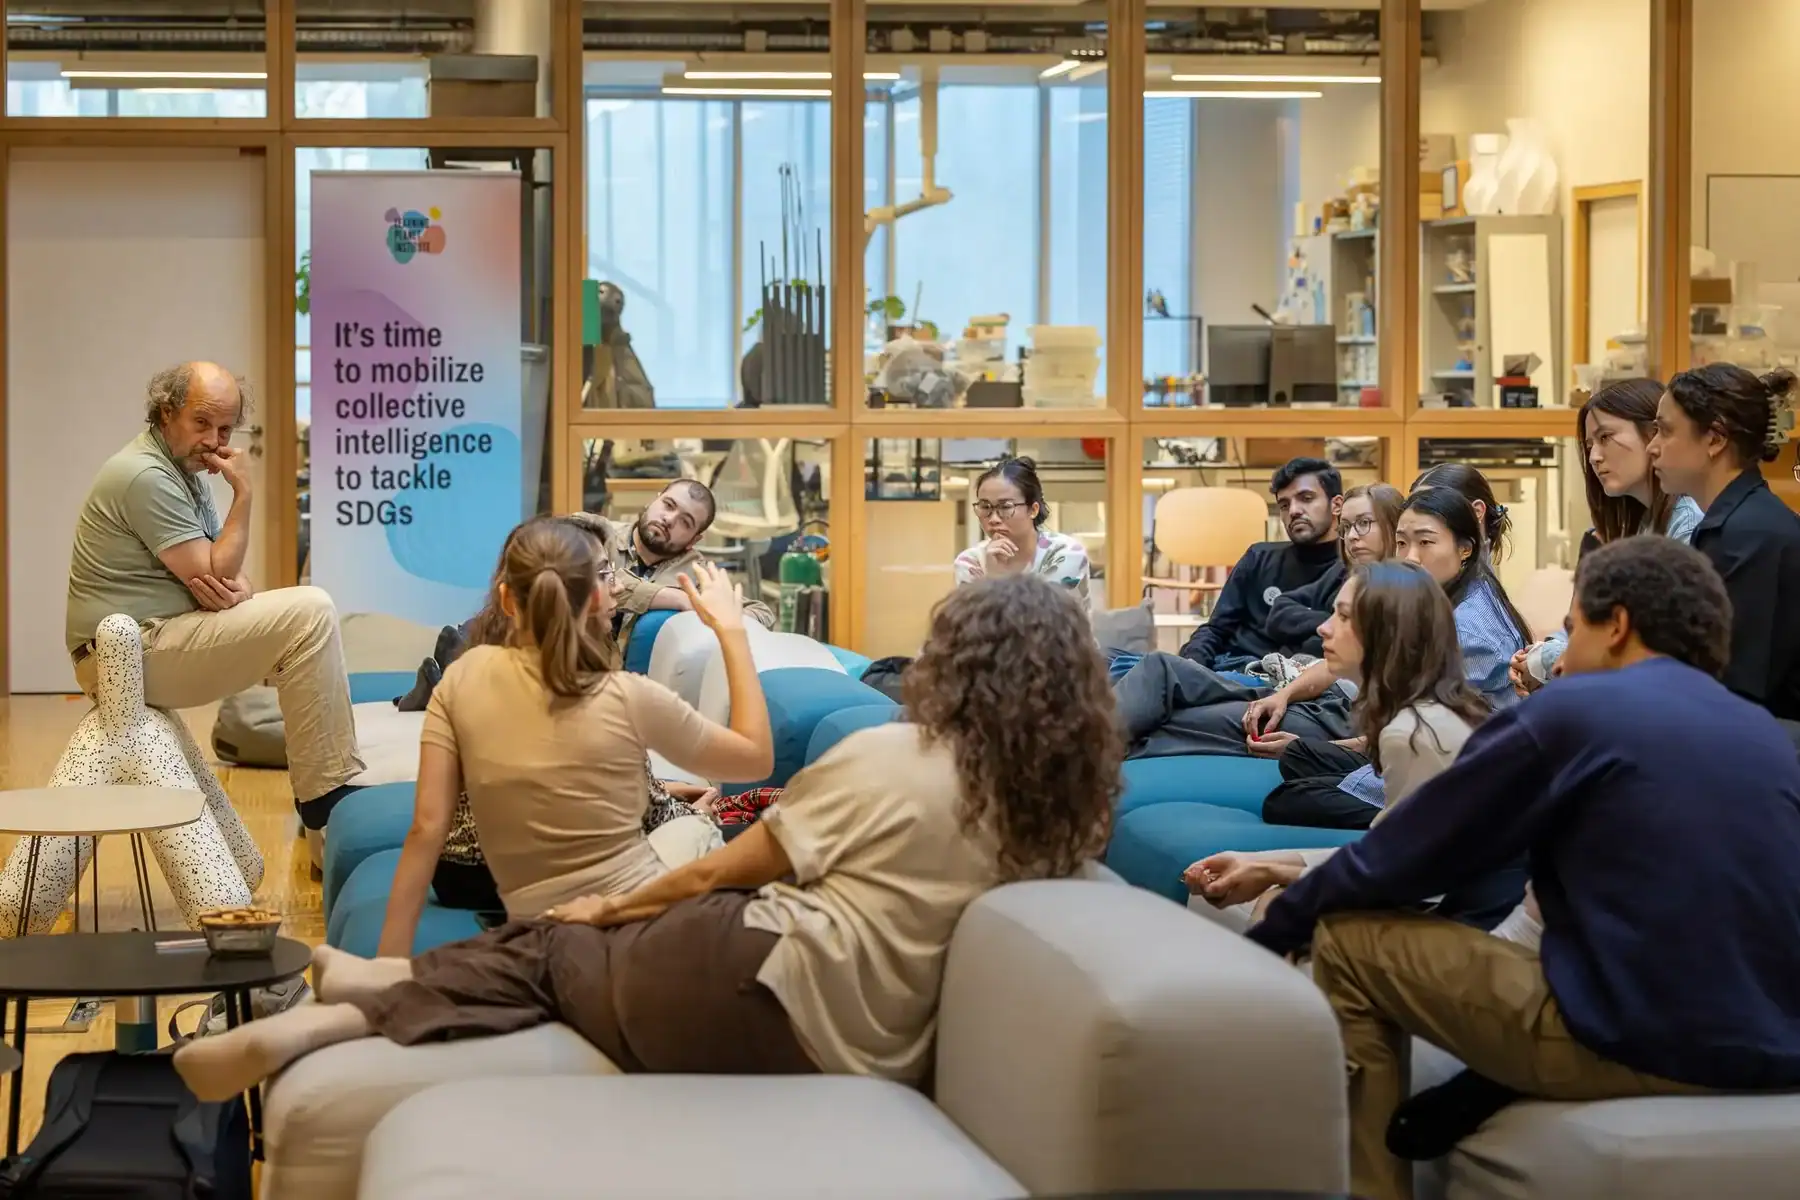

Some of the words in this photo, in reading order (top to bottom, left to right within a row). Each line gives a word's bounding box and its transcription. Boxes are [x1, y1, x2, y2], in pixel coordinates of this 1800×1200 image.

[335, 321, 374, 348] It's
[383, 320, 442, 348] time
[334, 358, 361, 383] to
[371, 356, 484, 383] mobilize
[336, 391, 465, 419] collective
[336, 427, 492, 460] intelligence
[335, 465, 361, 490] to
[370, 462, 451, 490] tackle
[336, 500, 413, 525] SDGs
